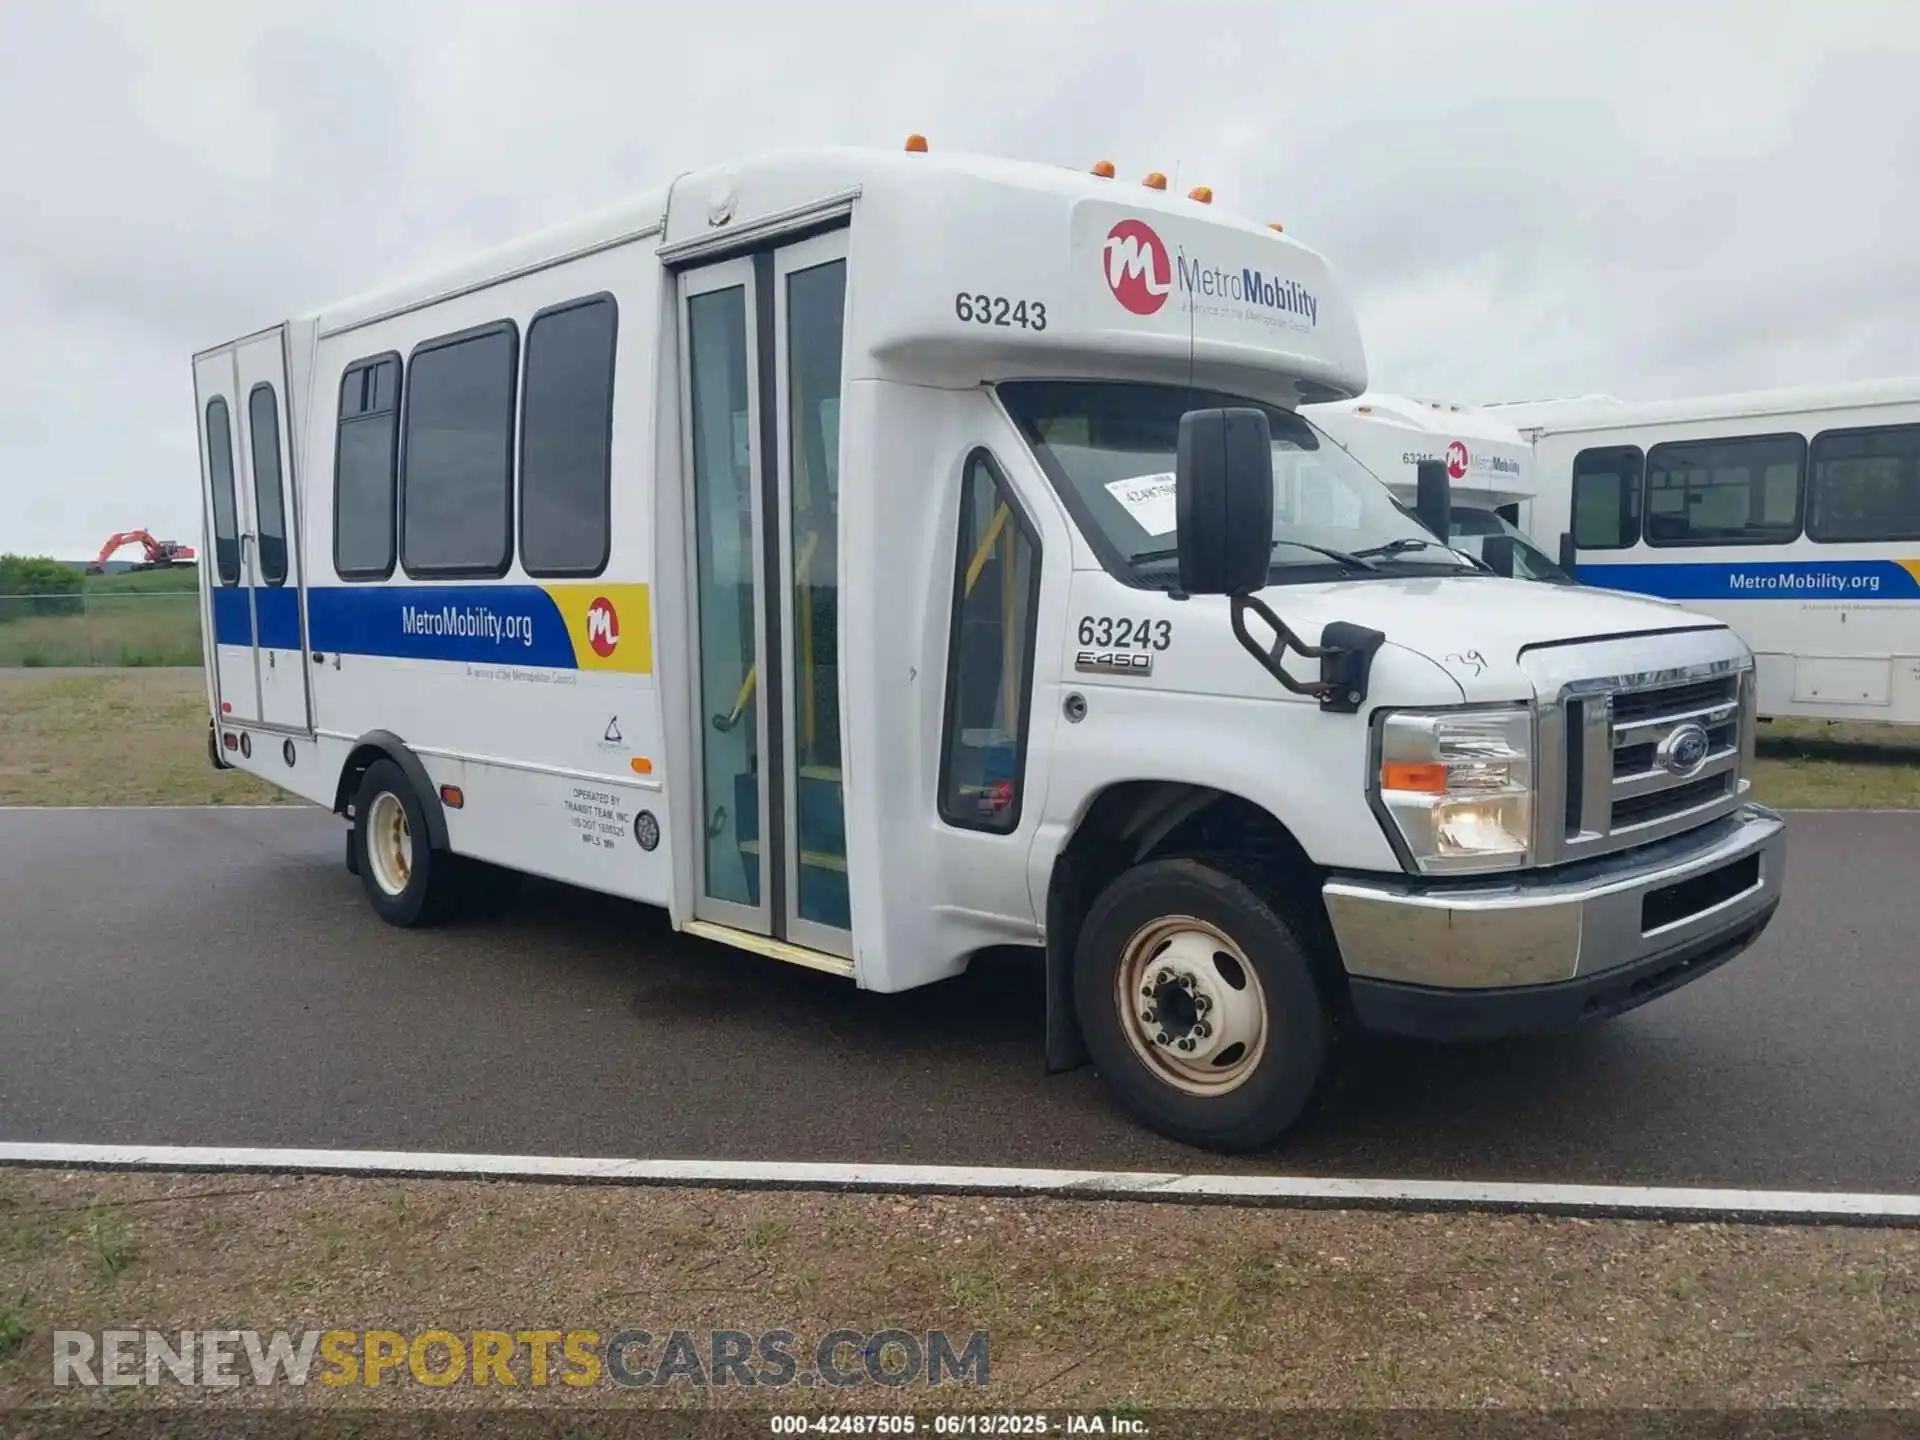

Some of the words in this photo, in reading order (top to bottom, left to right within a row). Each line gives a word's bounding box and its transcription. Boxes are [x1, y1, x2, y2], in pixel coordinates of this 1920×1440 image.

[1177, 255, 1317, 326] MetroMobility
[955, 292, 1047, 331] 63243
[1729, 573, 1880, 591] MetroMobility.org
[402, 606, 533, 646] MetroMobility.org
[1077, 615, 1173, 651] 63243
[573, 788, 609, 805] OPERATED
[611, 795, 620, 806] BY
